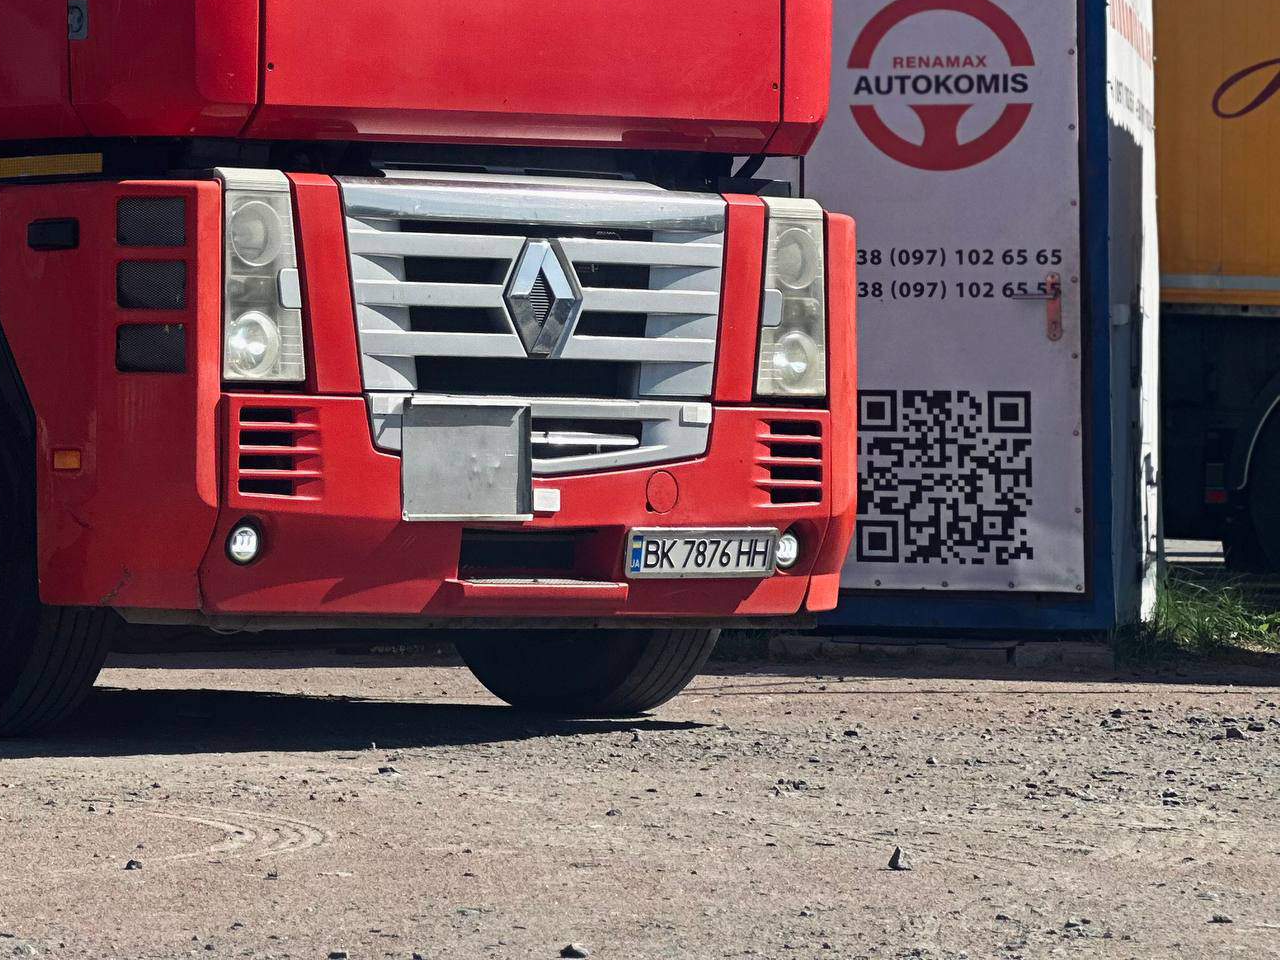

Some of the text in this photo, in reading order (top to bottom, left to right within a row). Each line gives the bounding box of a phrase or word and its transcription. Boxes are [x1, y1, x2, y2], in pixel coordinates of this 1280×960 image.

[892, 55, 987, 69] RENAMAX
[853, 72, 1029, 96] AUTOKOMIS
[890, 247, 947, 267] (097)
[955, 249, 995, 265] 102
[1001, 249, 1028, 265] 65
[1035, 249, 1062, 266] 65
[891, 280, 947, 300] (097)
[956, 281, 995, 298] 102
[1001, 281, 1028, 298] 65
[681, 539, 731, 569] 7876
[735, 538, 770, 568] HH
